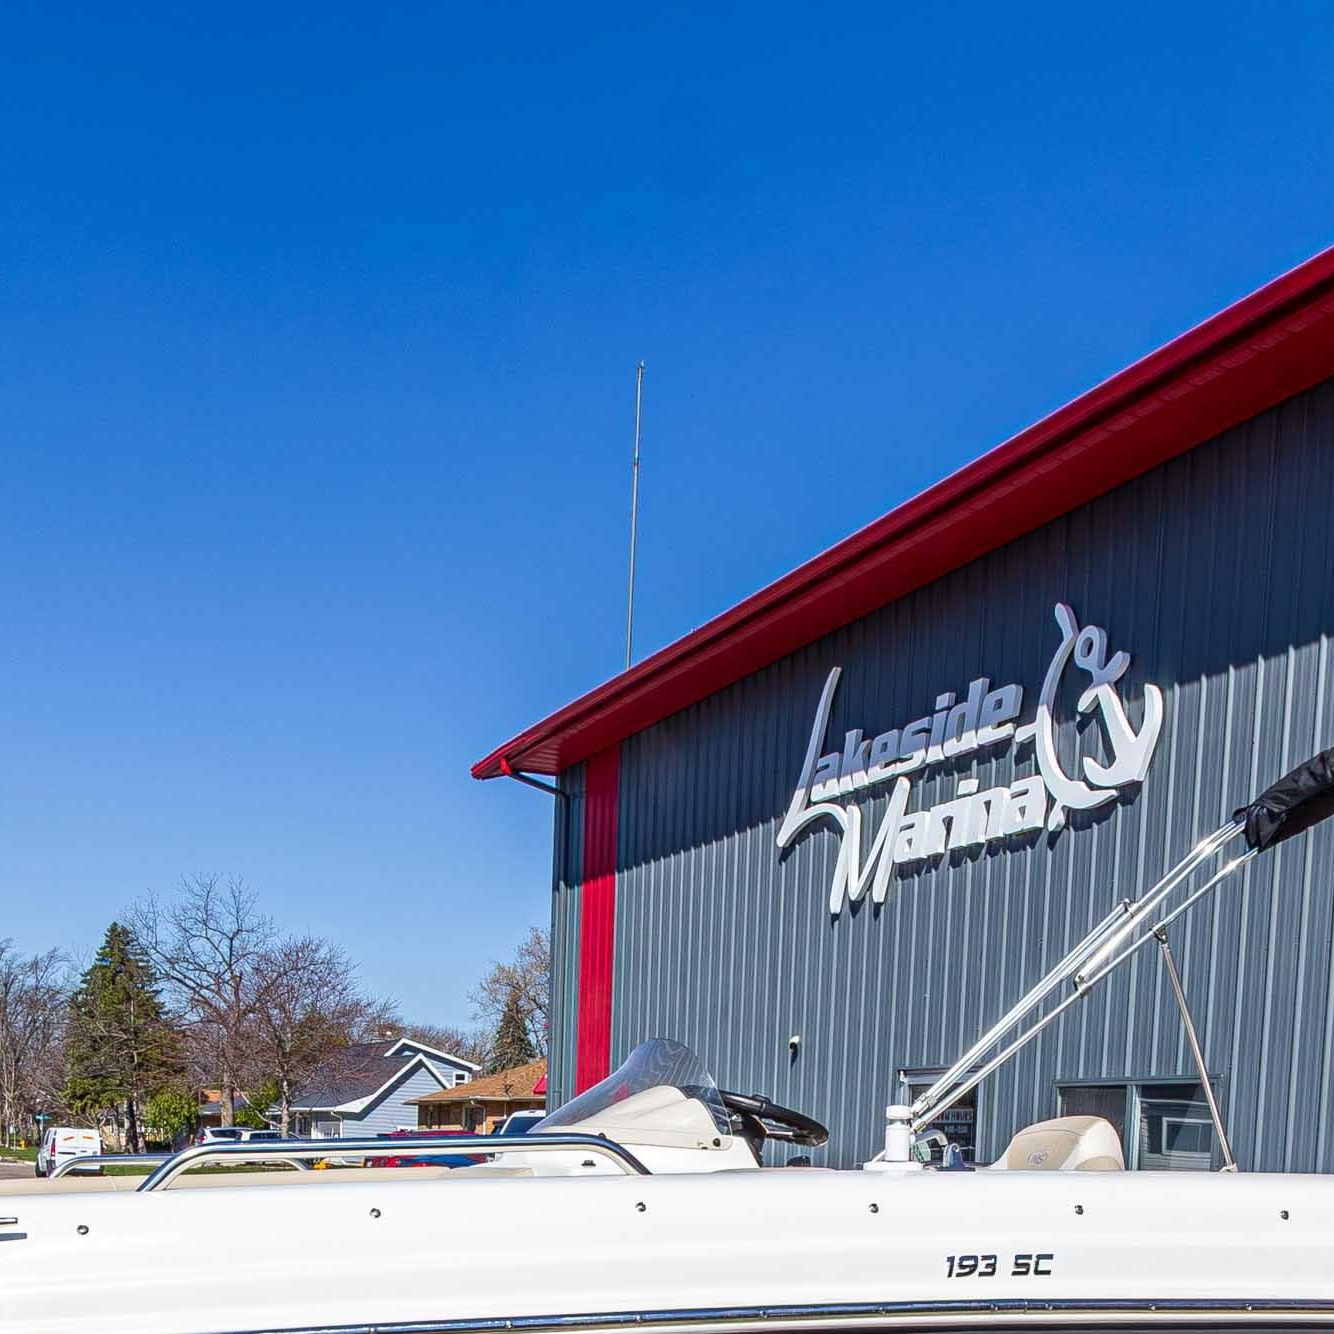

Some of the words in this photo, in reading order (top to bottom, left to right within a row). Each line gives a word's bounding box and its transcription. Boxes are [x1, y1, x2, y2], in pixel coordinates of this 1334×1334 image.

[776, 666, 1024, 848] Lakeside
[829, 775, 1047, 915] Marina
[946, 1254, 997, 1278] 193
[1011, 1253, 1054, 1276] SC
